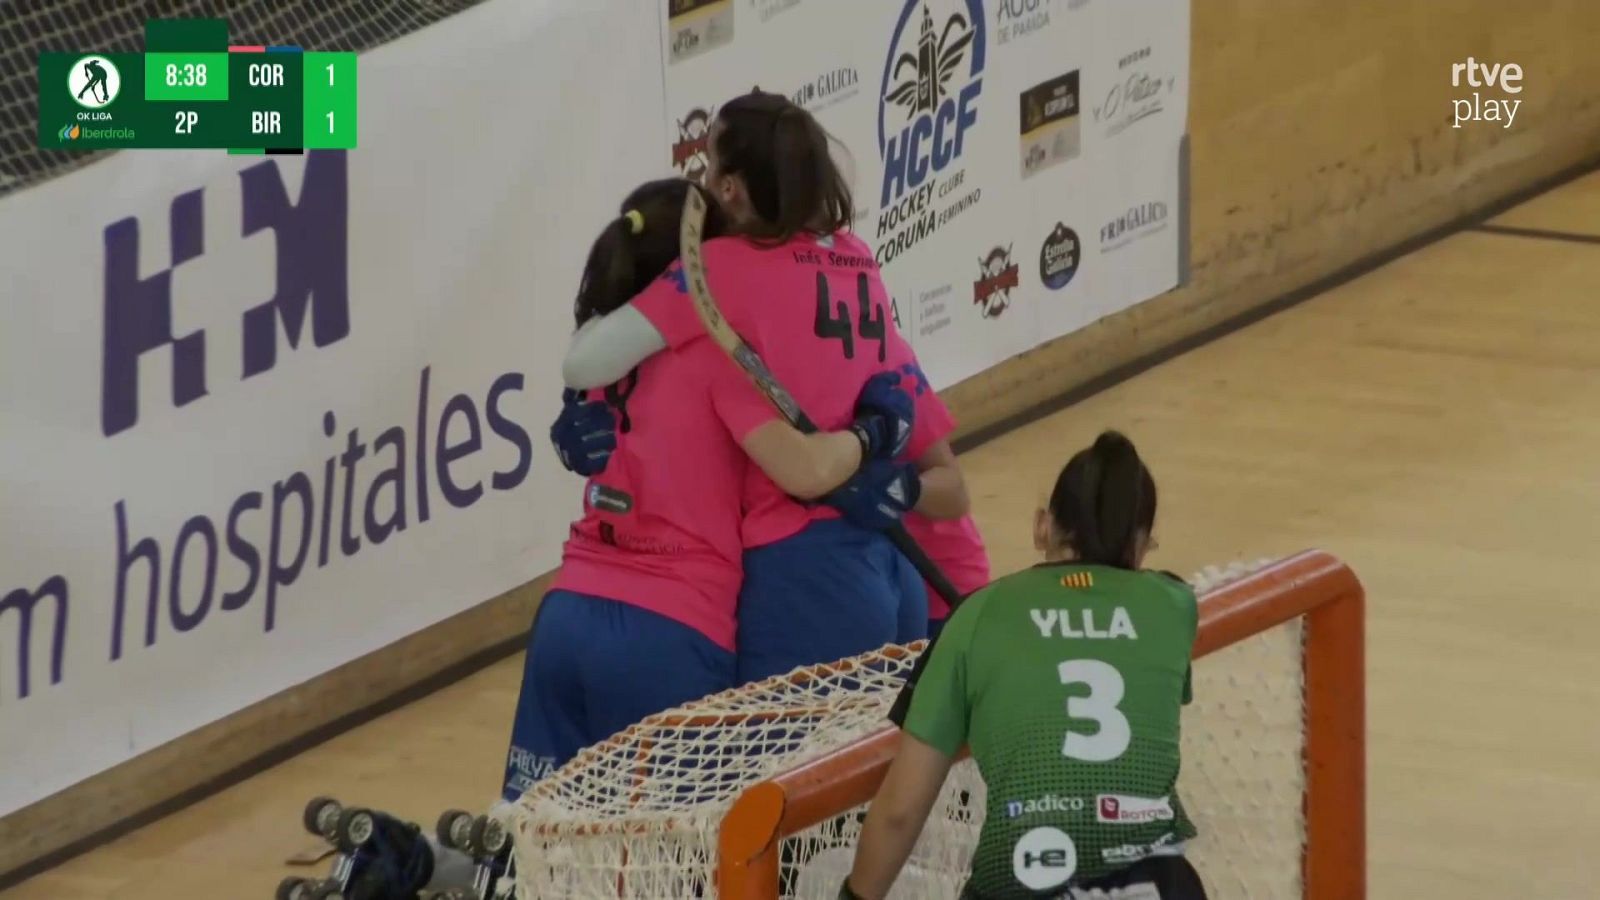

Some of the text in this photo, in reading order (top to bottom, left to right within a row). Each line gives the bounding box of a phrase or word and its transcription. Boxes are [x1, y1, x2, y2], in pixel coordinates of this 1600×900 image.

[817, 68, 859, 98] GALICIA
[880, 78, 983, 210] HCCF
[875, 188, 982, 269] CORUÑA FEMININO
[877, 169, 965, 239] HOCKEY CLUBE
[814, 271, 886, 362] 44
[109, 364, 533, 661] hospitales
[1029, 606, 1138, 640] YLLA
[1056, 659, 1132, 762] 3
[1007, 794, 1084, 818] nadico
